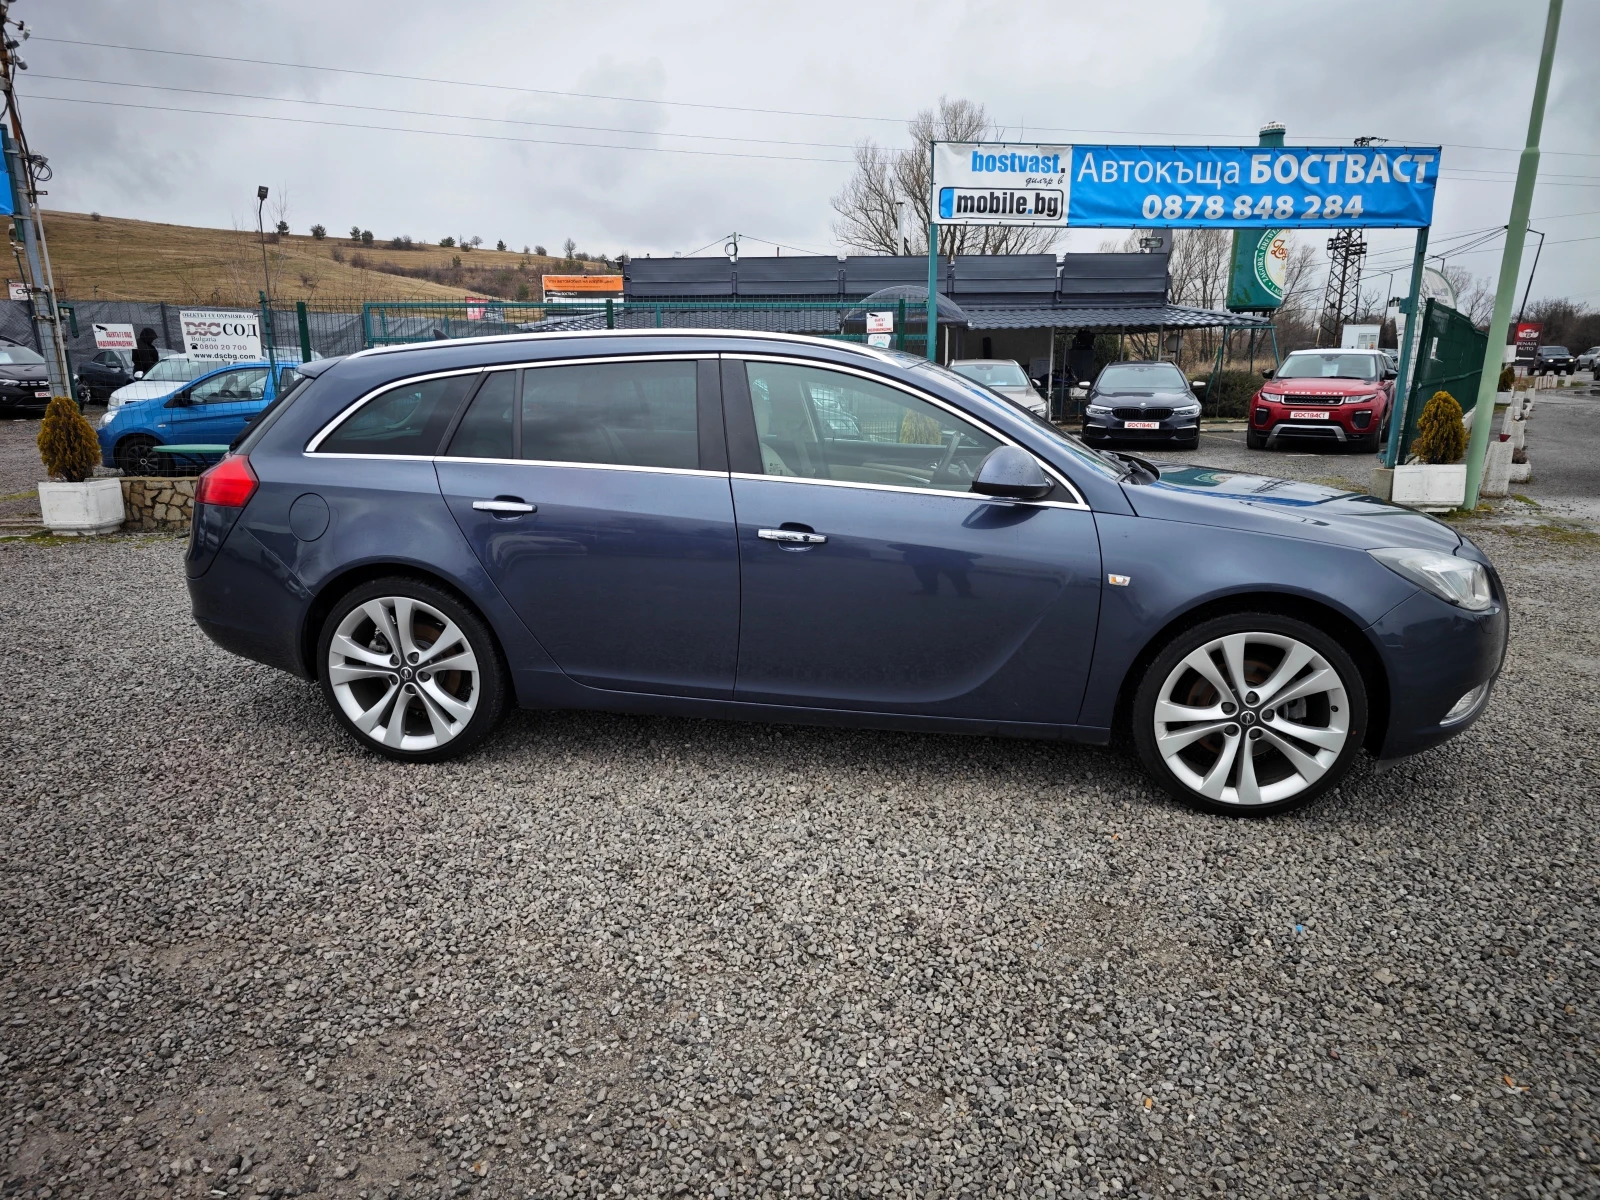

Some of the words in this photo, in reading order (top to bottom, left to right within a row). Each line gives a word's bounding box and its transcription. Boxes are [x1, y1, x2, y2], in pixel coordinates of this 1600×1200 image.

[972, 151, 1065, 174] bostvast.
[1077, 152, 1240, 190] Автокъща
[1250, 153, 1434, 184] БОСТВАСТ
[956, 192, 1058, 217] mobile.bg
[1142, 194, 1225, 220] 0878
[1232, 195, 1294, 220] 848
[1300, 195, 1364, 219] 284
[1257, 252, 1269, 283] ZAGORKA
[184, 322, 221, 336] DSC
[223, 323, 258, 339] СОД
